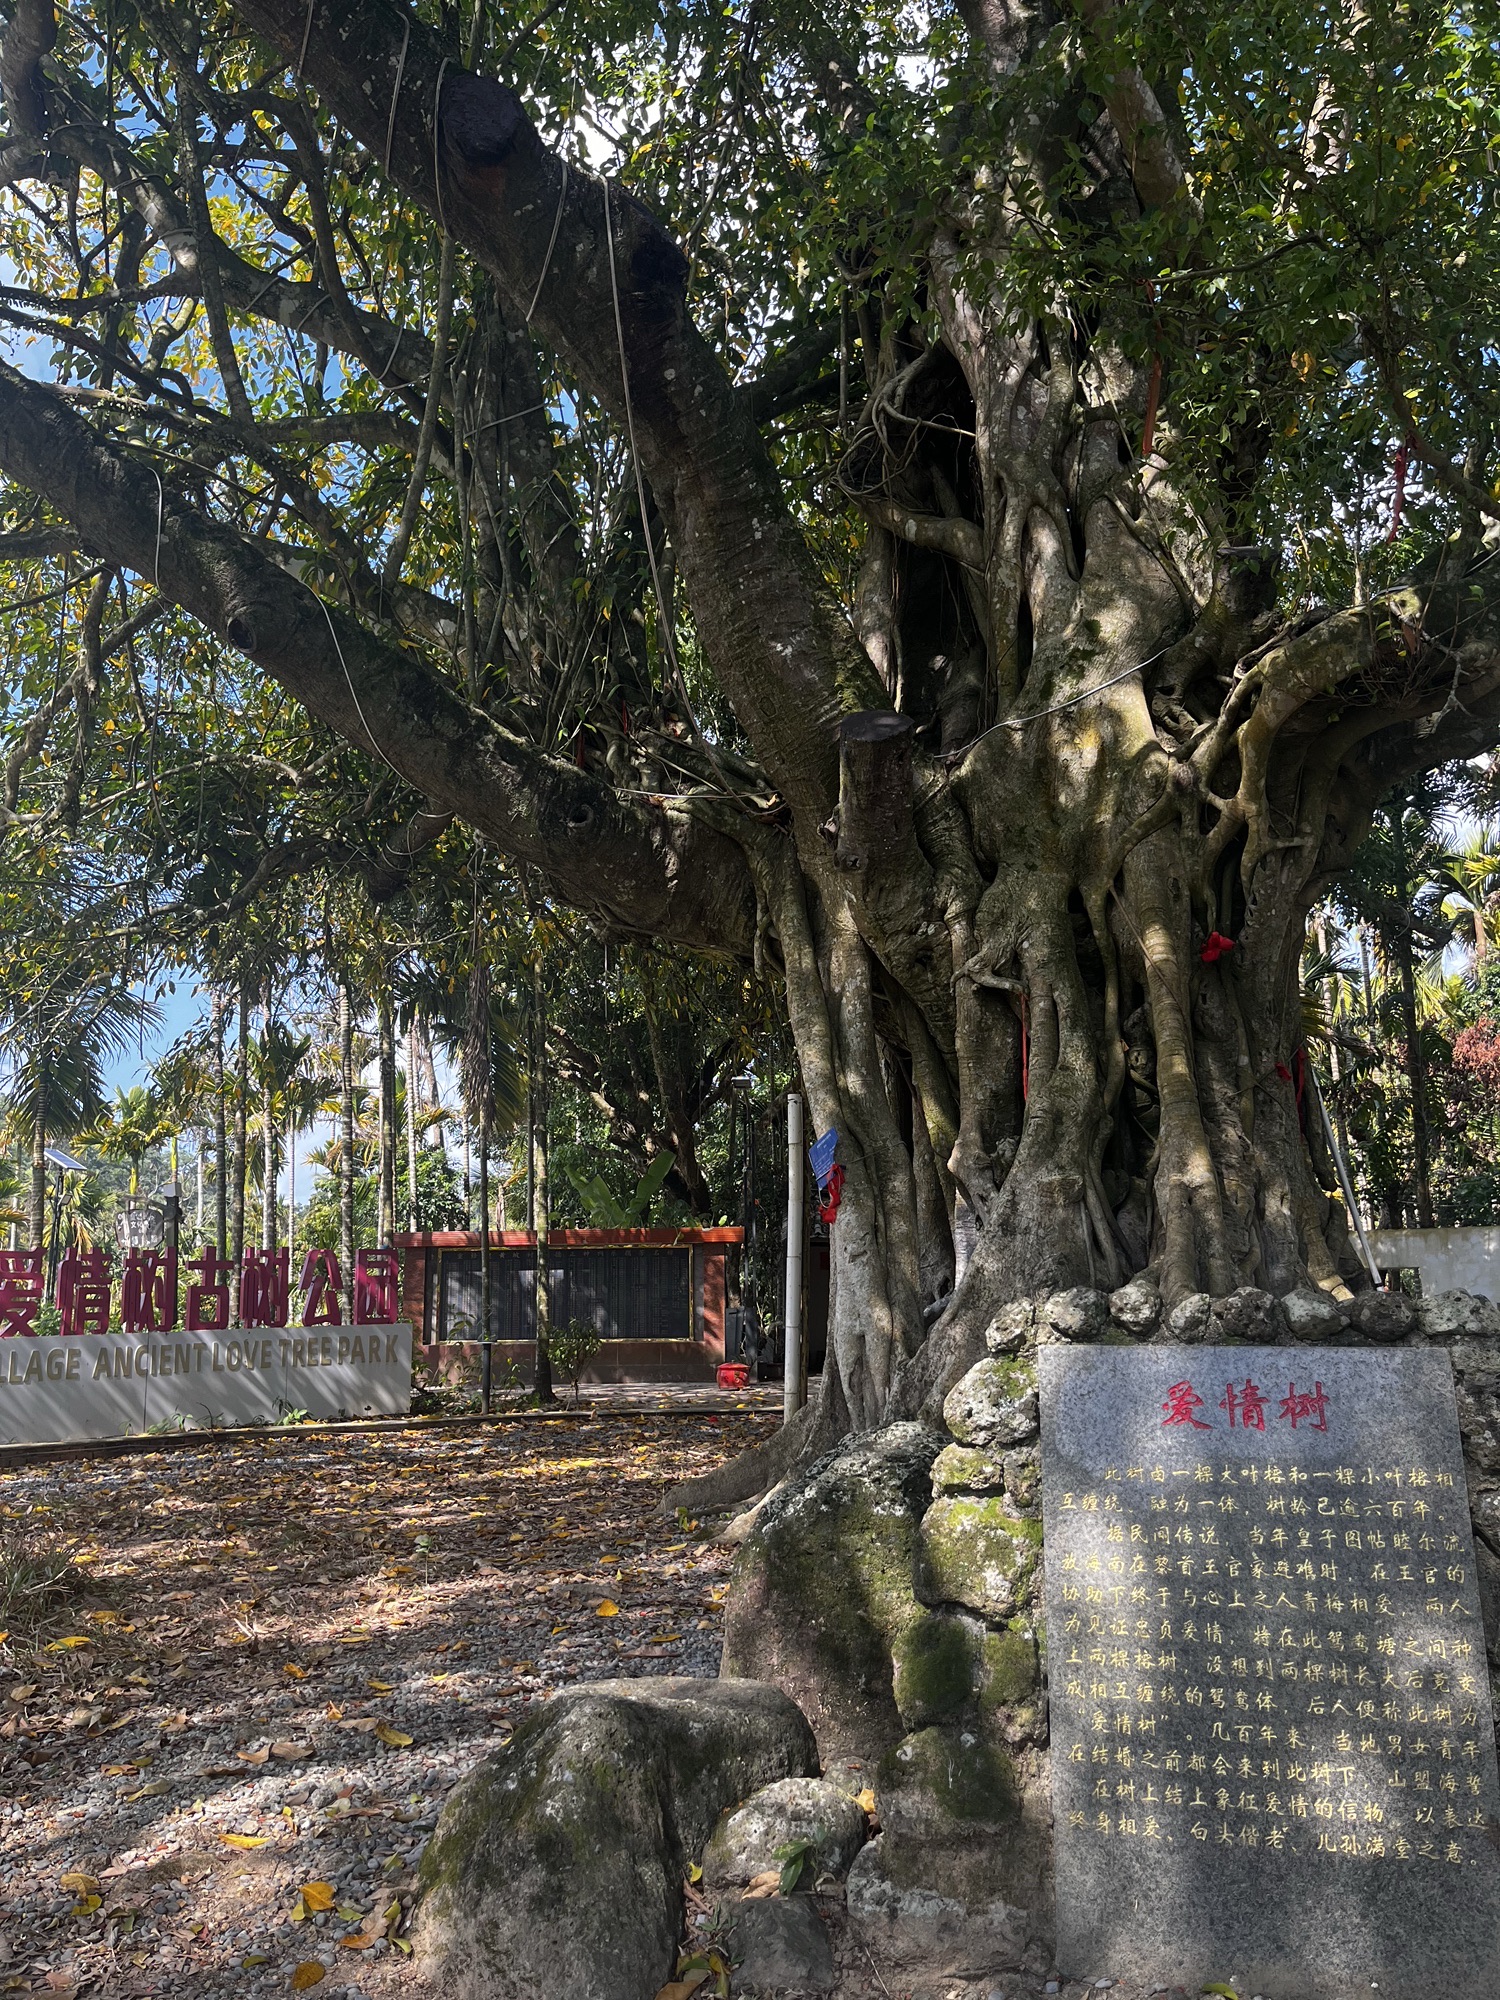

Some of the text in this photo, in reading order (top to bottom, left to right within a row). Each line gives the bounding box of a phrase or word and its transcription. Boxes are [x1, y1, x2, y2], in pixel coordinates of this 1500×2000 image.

[0, 1246, 399, 1338] 爱情树古树公园
[92, 1342, 208, 1380] ANCIENT
[212, 1339, 273, 1372] LOVE
[278, 1336, 333, 1368] TREE
[337, 1334, 399, 1365] PARK
[1161, 1378, 1330, 1431] 爱情树
